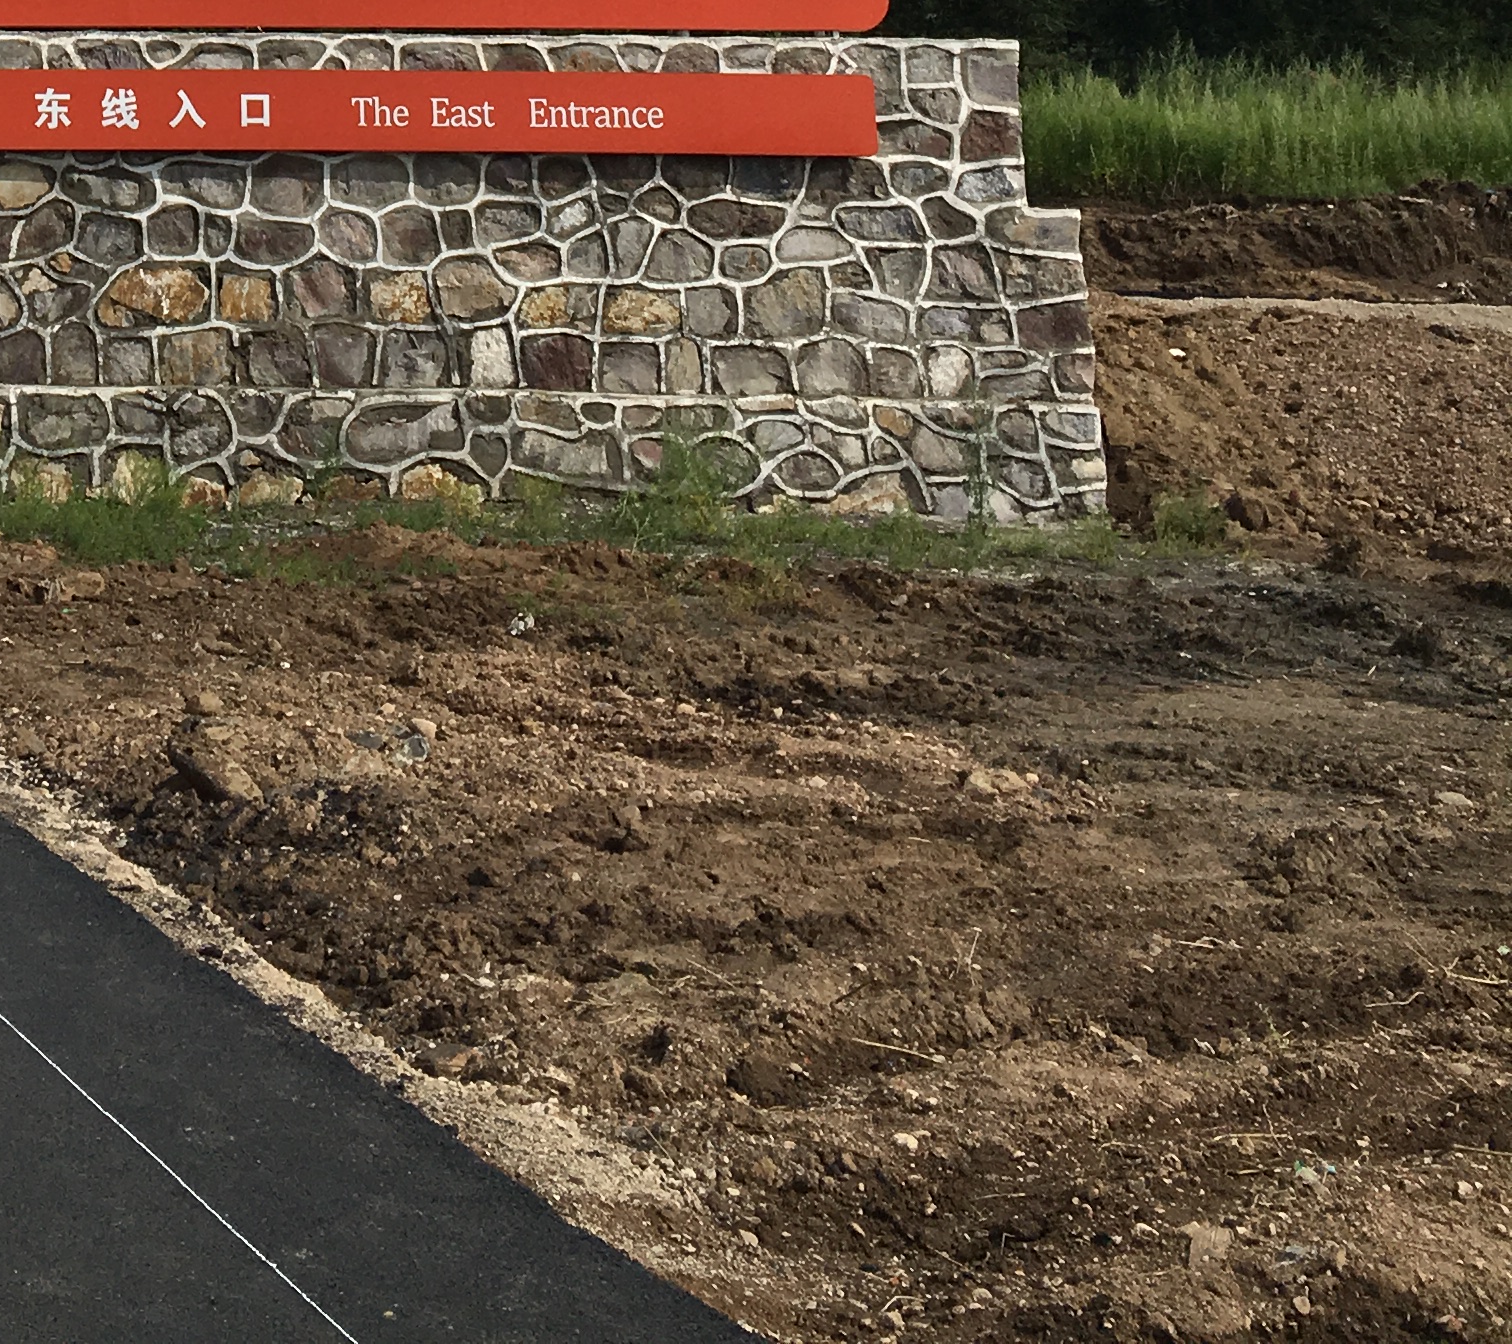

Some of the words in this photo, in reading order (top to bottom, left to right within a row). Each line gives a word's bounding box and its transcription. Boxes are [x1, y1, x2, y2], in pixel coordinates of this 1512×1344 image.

[34, 87, 272, 130] 东线入口
[351, 96, 410, 127] The
[430, 97, 496, 128] East
[528, 98, 664, 129] Entrance
